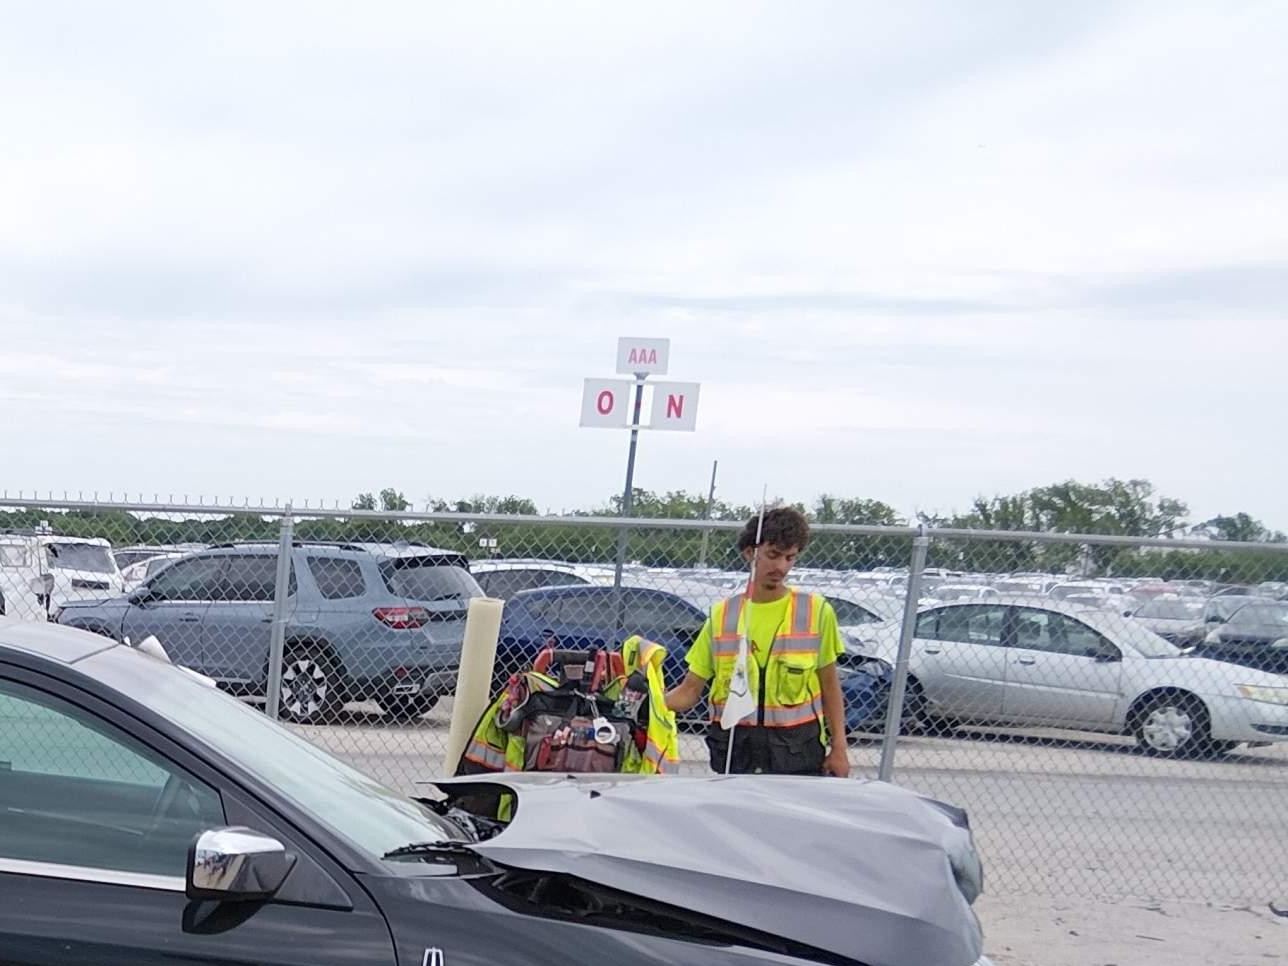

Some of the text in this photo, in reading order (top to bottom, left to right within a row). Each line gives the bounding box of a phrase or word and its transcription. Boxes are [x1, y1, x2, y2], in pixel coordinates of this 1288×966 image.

[628, 348, 657, 364] AAA
[597, 390, 614, 415] O
[666, 394, 684, 419] N
